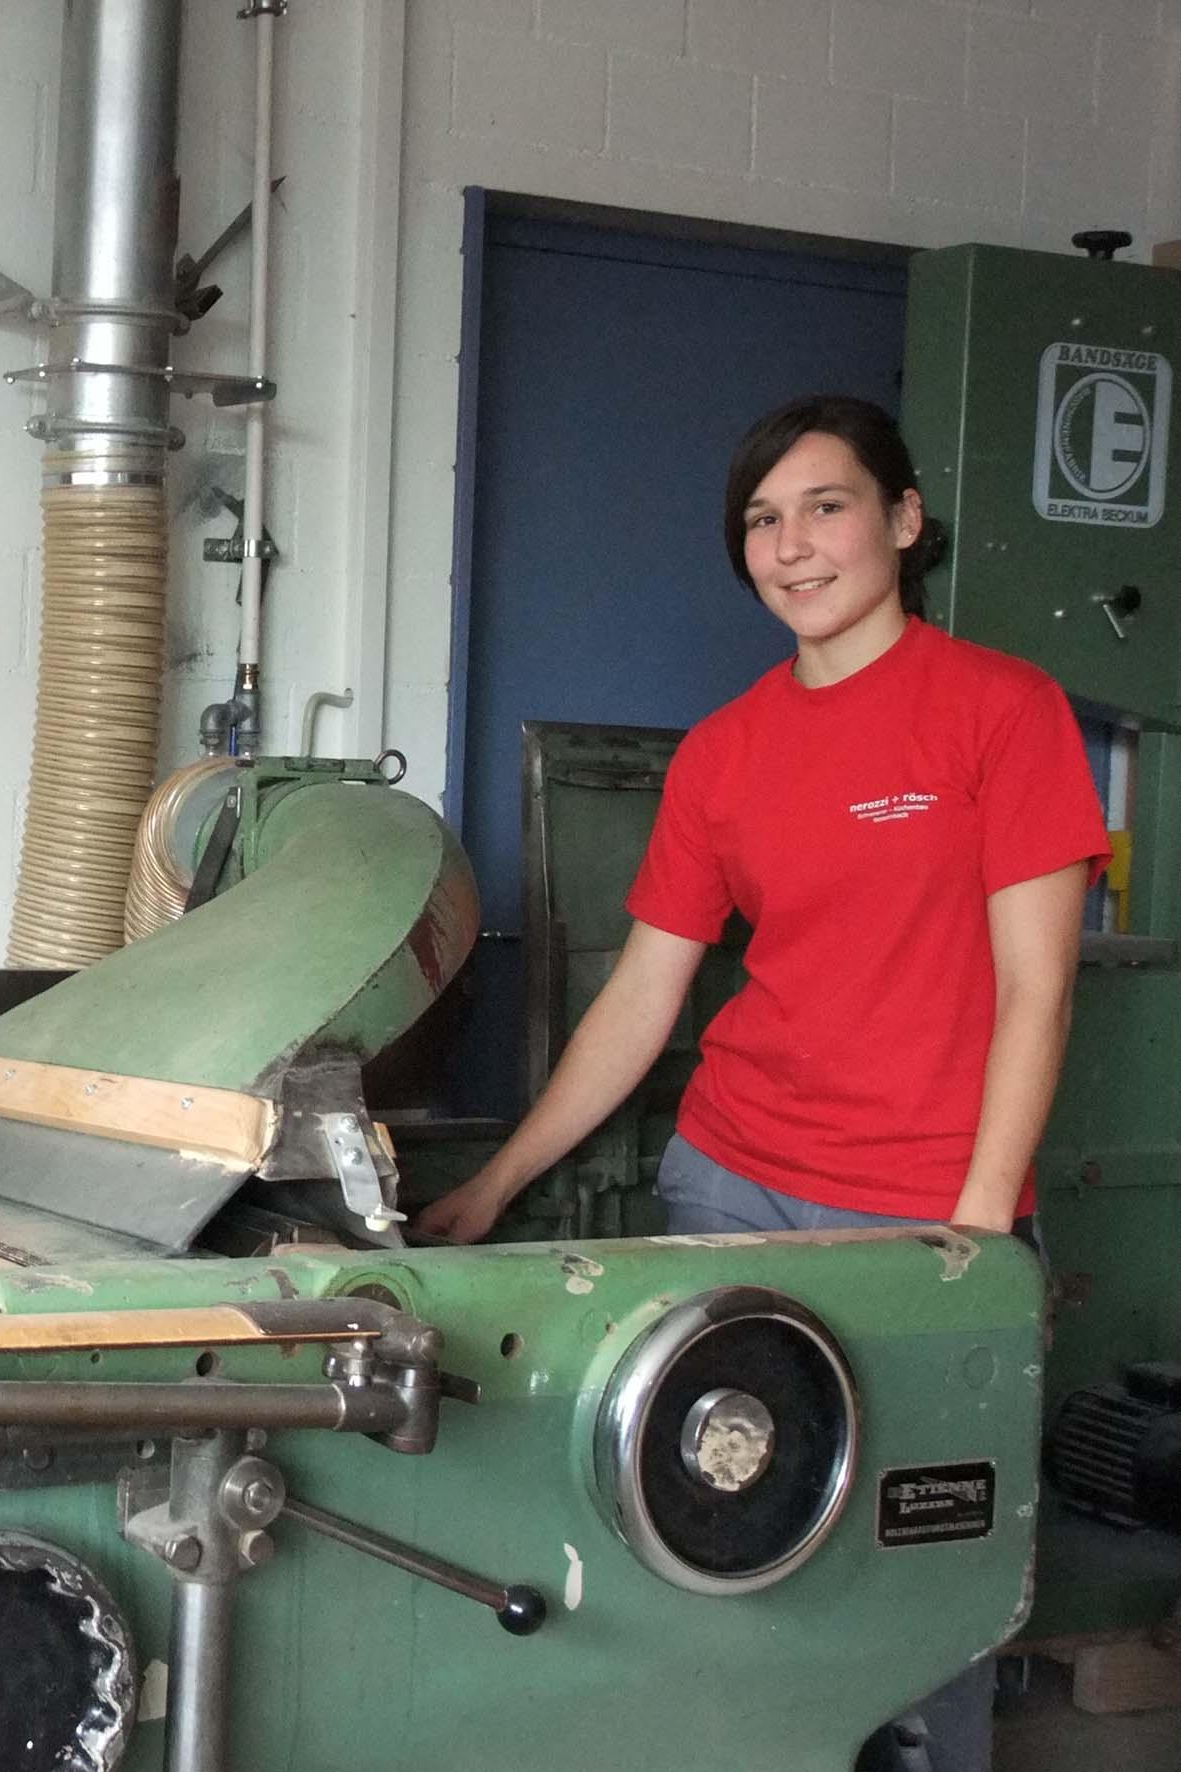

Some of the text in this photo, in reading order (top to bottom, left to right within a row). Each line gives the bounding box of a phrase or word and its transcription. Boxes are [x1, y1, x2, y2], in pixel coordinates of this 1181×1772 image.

[1059, 344, 1157, 370] BANDSÄGE
[1047, 503, 1148, 523] ELEKTRA BECKUM
[850, 796, 889, 813] nerozzi
[903, 792, 938, 802] rösch
